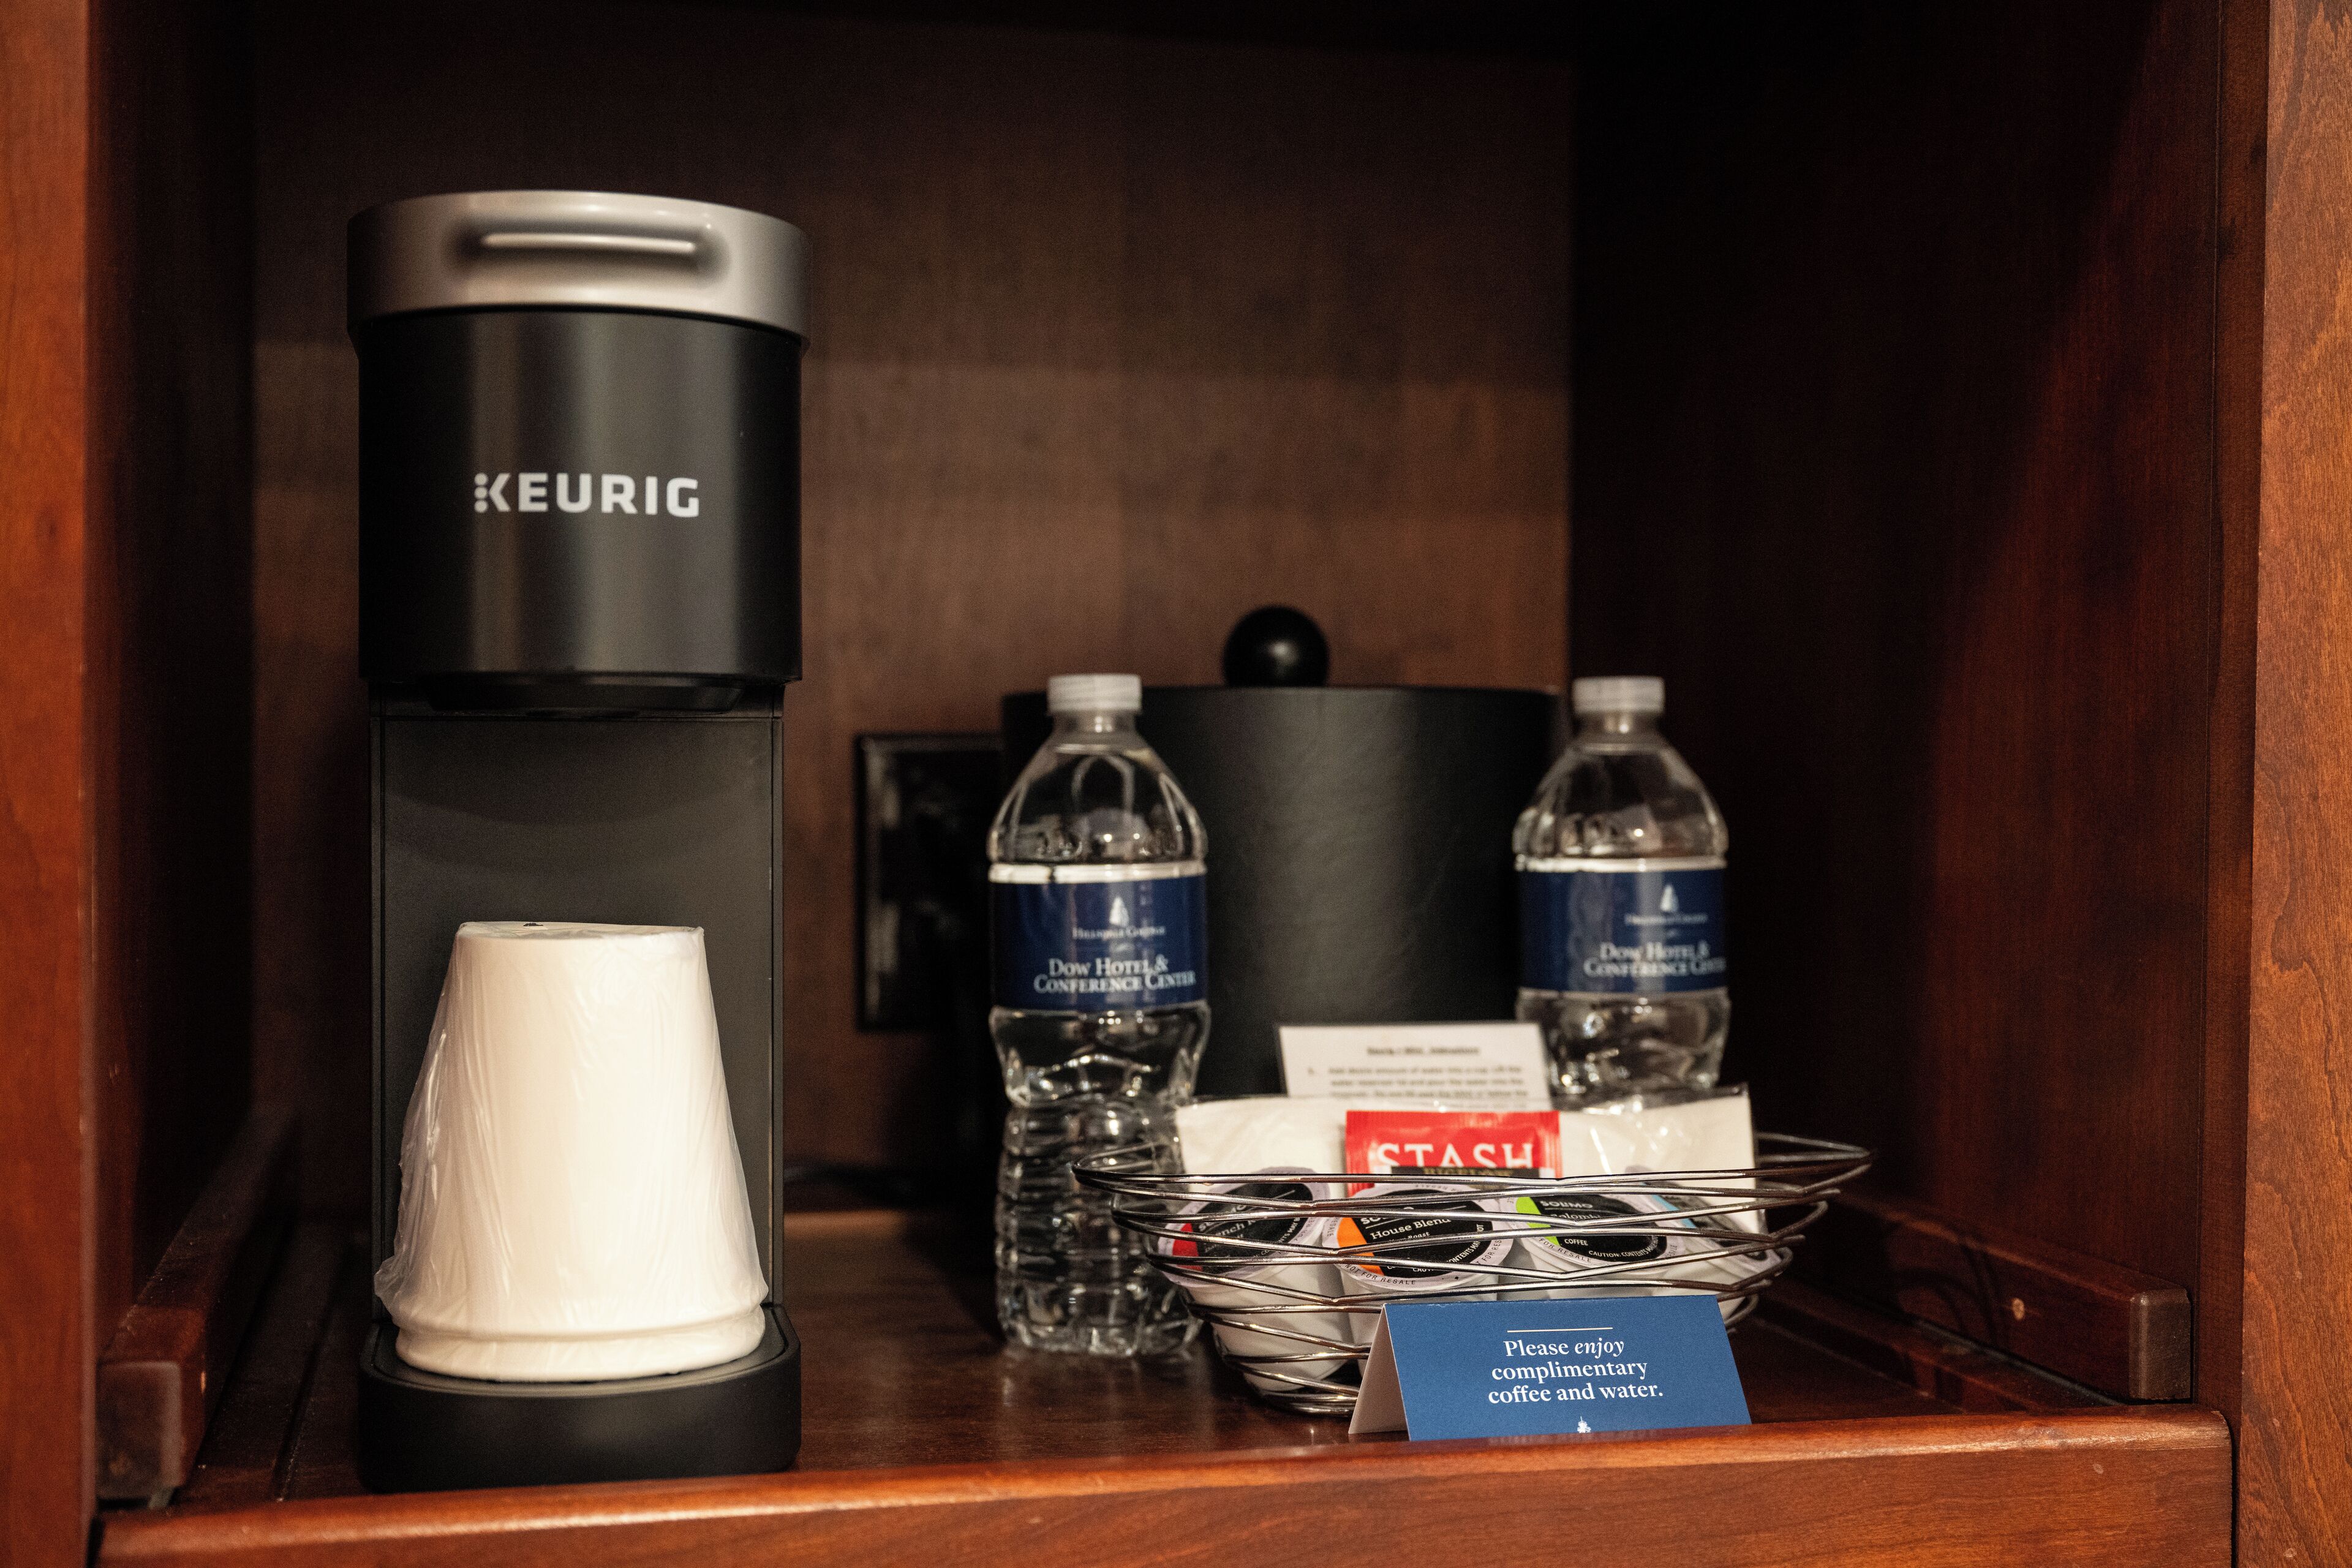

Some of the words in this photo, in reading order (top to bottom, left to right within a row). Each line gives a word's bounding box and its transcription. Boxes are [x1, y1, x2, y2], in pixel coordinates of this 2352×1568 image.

[474, 472, 699, 518] KEURIG
[1376, 1142, 1533, 1167] STASH
[1370, 1224, 1412, 1240] House
[1361, 1271, 1378, 1281] FOR
[1381, 1276, 1417, 1286] RESALE
[1503, 1340, 1570, 1357] Please
[1574, 1337, 1624, 1359] enjoy
[1491, 1361, 1648, 1384] complimentary
[1488, 1385, 1552, 1404] coffee
[1556, 1382, 1596, 1401] and
[1598, 1384, 1664, 1399] water.
